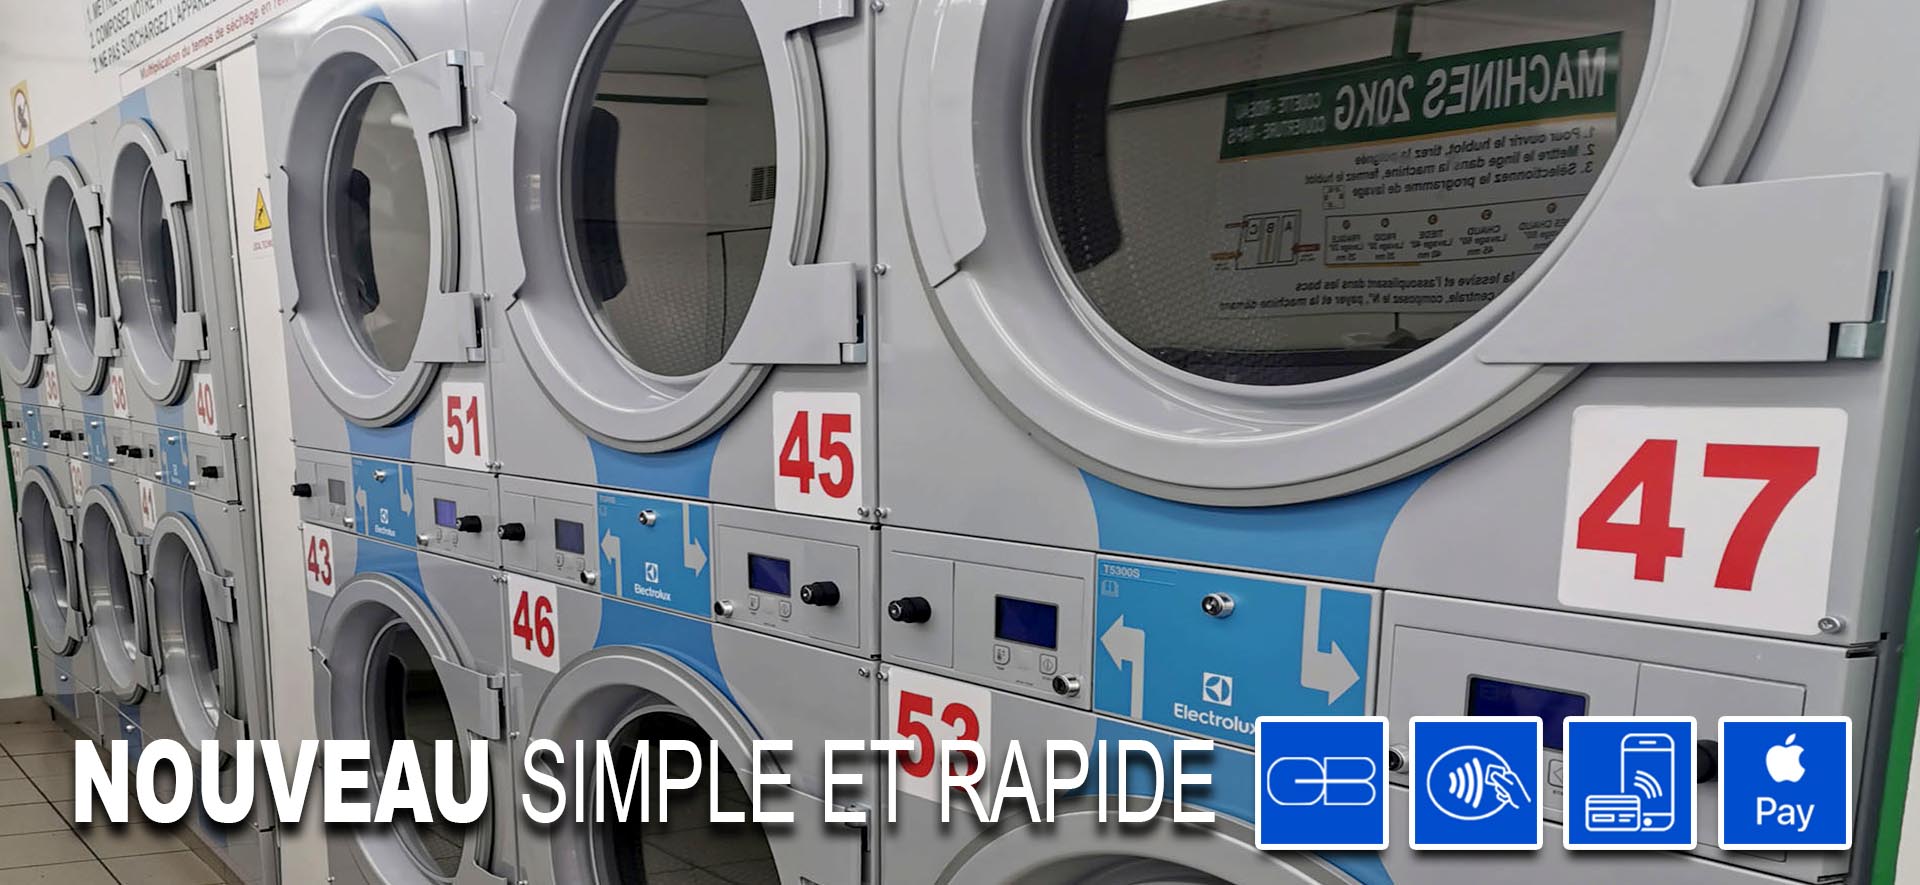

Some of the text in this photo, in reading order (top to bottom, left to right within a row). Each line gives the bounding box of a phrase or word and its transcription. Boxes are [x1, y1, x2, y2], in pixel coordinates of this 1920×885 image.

[96, 7, 131, 44] COMPOSEZ
[108, 42, 121, 65] PAS
[121, 11, 170, 56] SURCHARGEZ
[191, 32, 214, 53] temps
[214, 27, 225, 40] de
[111, 375, 127, 411] 38
[197, 383, 214, 426] 40
[447, 395, 481, 457] 51
[779, 410, 854, 498] 45
[141, 486, 157, 516] 41
[1576, 438, 1820, 592] 47
[307, 535, 333, 587] 43
[1103, 564, 1141, 579] T5300S
[634, 582, 672, 602] Electrolux
[513, 590, 555, 657] 46
[897, 690, 980, 793] 53
